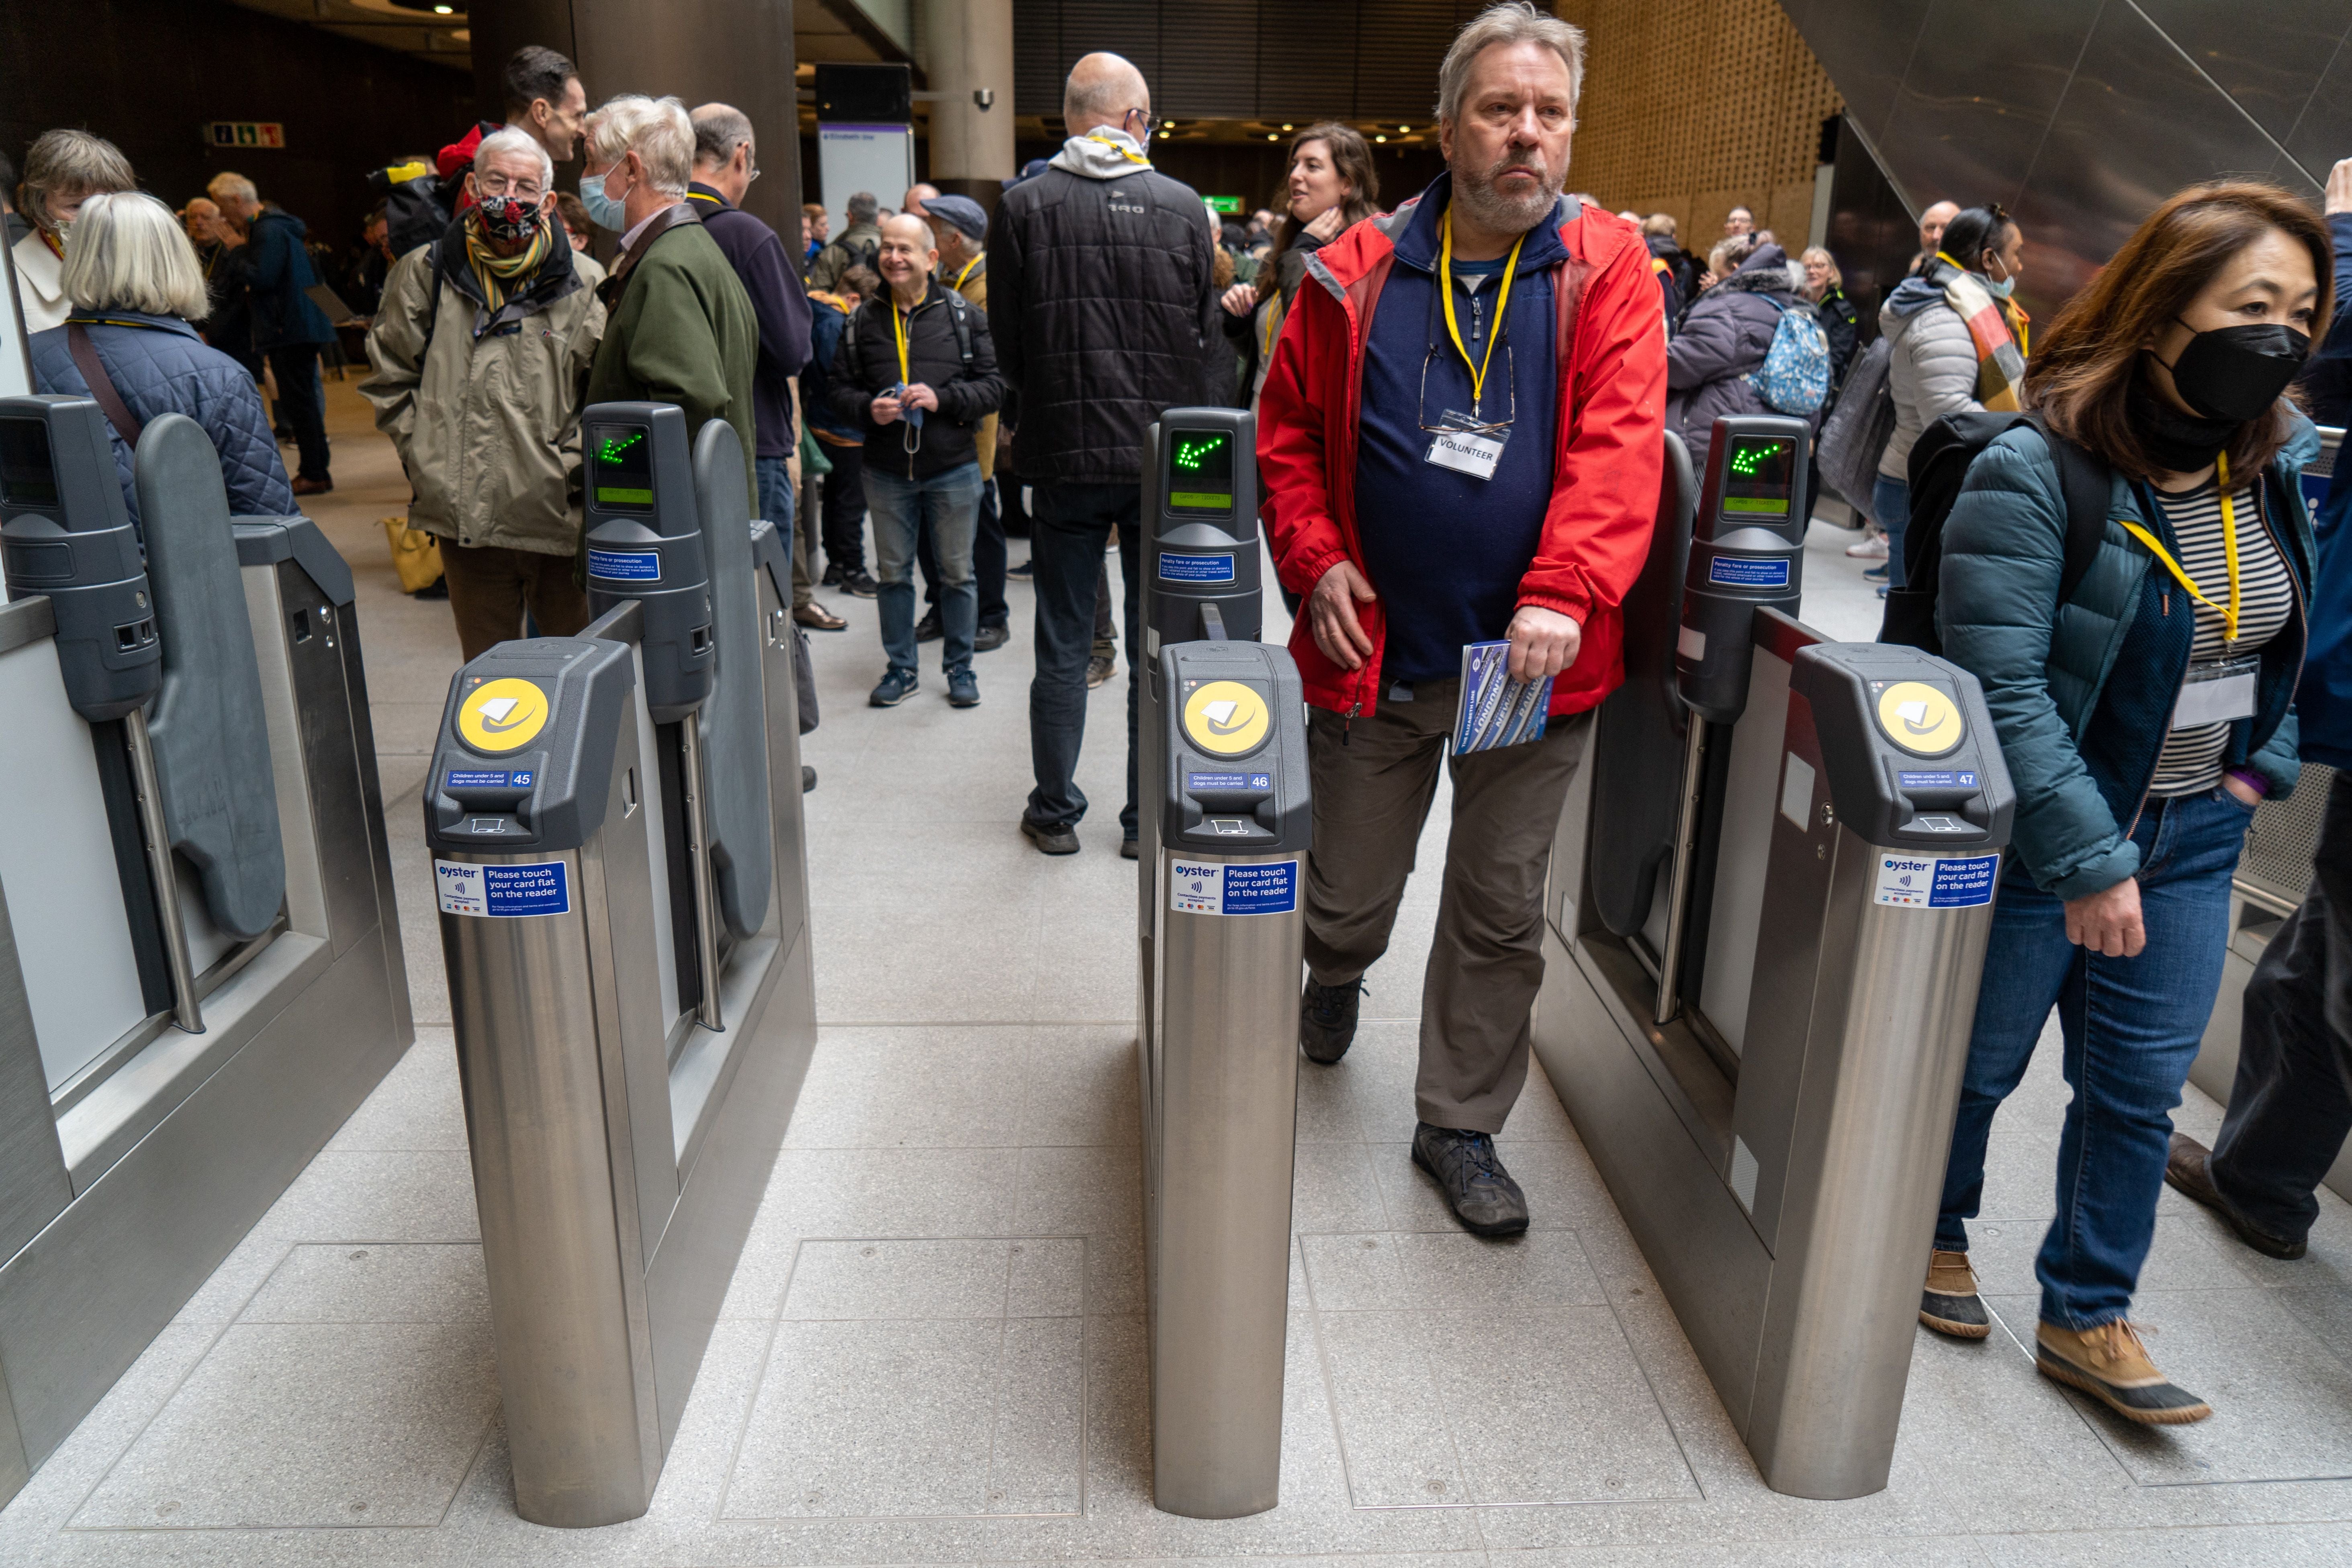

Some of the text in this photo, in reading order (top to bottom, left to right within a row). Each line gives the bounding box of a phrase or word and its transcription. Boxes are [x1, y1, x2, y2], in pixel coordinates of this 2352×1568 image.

[1441, 439, 1493, 461] VOLUNTEER
[1519, 677, 1541, 718] RAILW
[1474, 673, 1504, 734] LONDON'S
[1465, 704, 1474, 736] ELIZABETH
[513, 775, 530, 784] 45
[1252, 777, 1268, 787] 46
[1959, 775, 1973, 784] 47
[1885, 861, 1928, 871] oyster
[1968, 861, 1989, 870] touch
[439, 866, 476, 878] oyster
[522, 869, 551, 877] touch
[1176, 866, 1216, 877] oyster
[1260, 868, 1285, 876] touch
[1959, 872, 1976, 880] card
[514, 880, 535, 888] card
[538, 878, 555, 887] flat
[1965, 880, 1988, 888] reader
[525, 889, 557, 897] reader
[1260, 887, 1288, 895] reader
